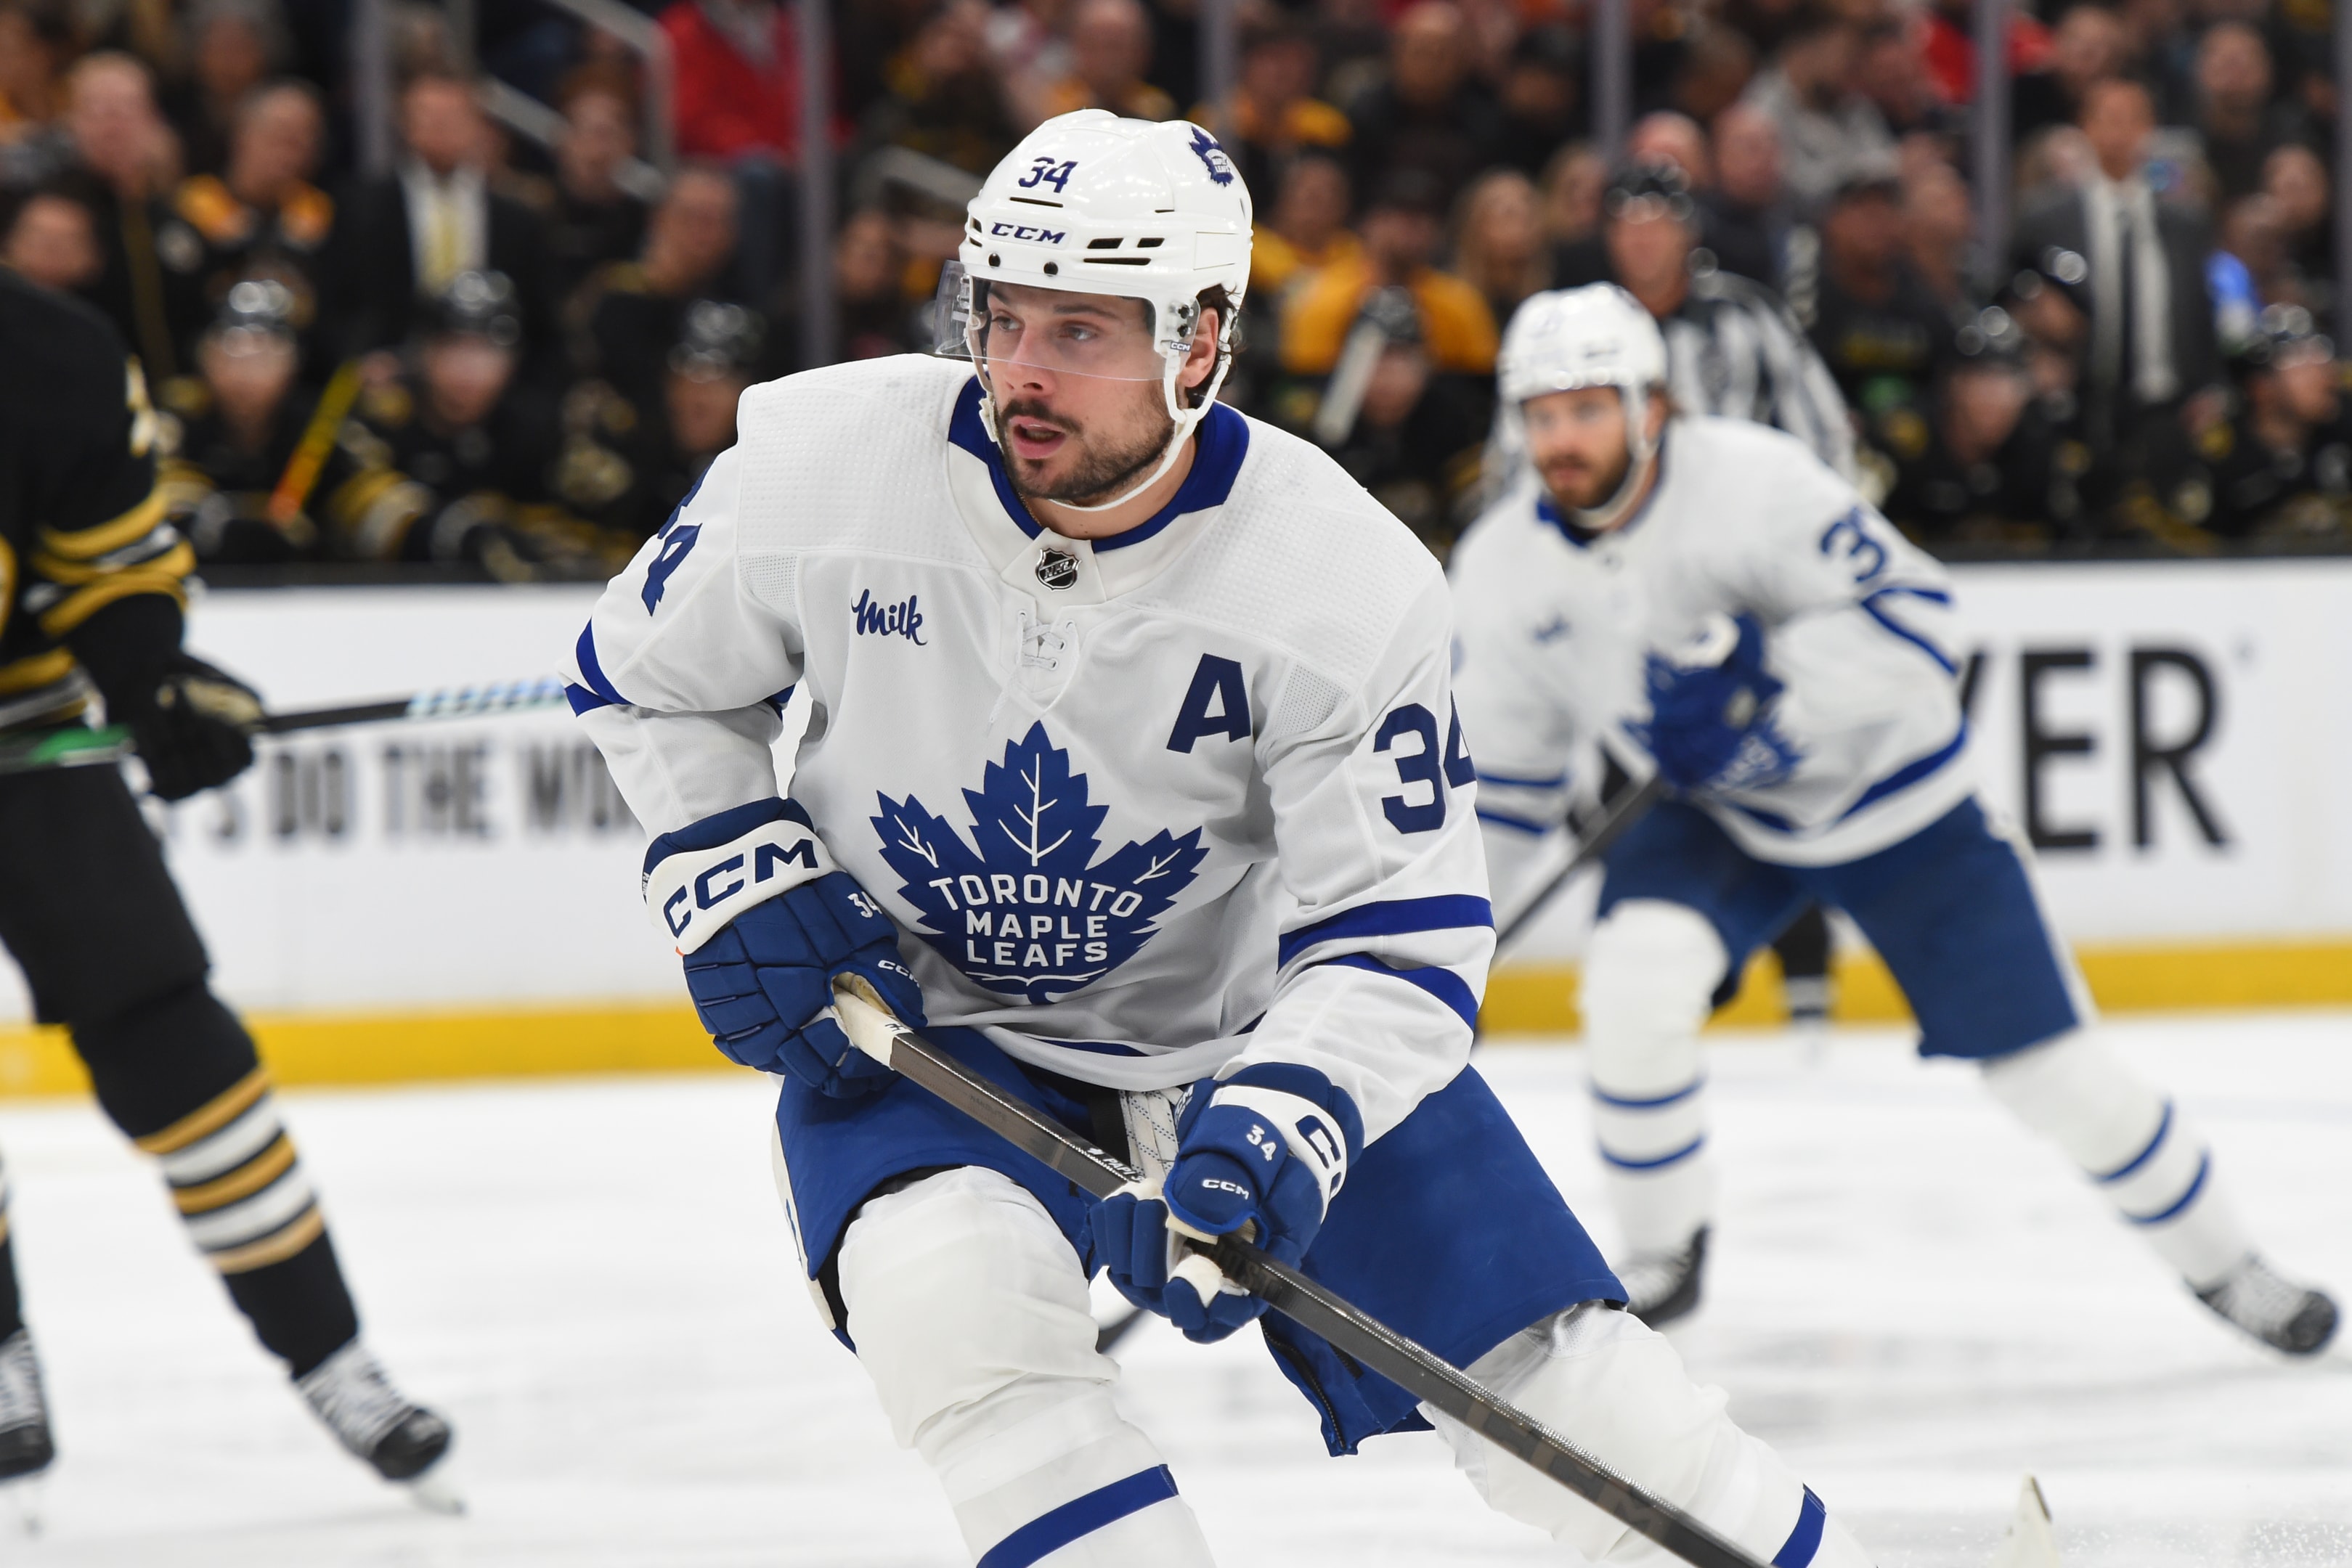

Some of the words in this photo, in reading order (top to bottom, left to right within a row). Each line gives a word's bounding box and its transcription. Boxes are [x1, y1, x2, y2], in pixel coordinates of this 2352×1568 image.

[1018, 156, 1079, 194] 34
[990, 221, 1066, 245] CCM
[1171, 342, 1191, 351] CCM
[1044, 560, 1073, 579] NHL
[850, 588, 928, 646] Milk
[1165, 653, 1251, 754] A
[380, 739, 492, 838] THE
[663, 838, 819, 939] CCM
[929, 873, 1143, 918] TORONTO
[966, 910, 1108, 939] MAPLE
[966, 939, 1108, 967] LEAFS
[1245, 1124, 1277, 1161] 34
[1102, 1158, 1136, 1175] PAPI
[1202, 1179, 1250, 1200] CCM
